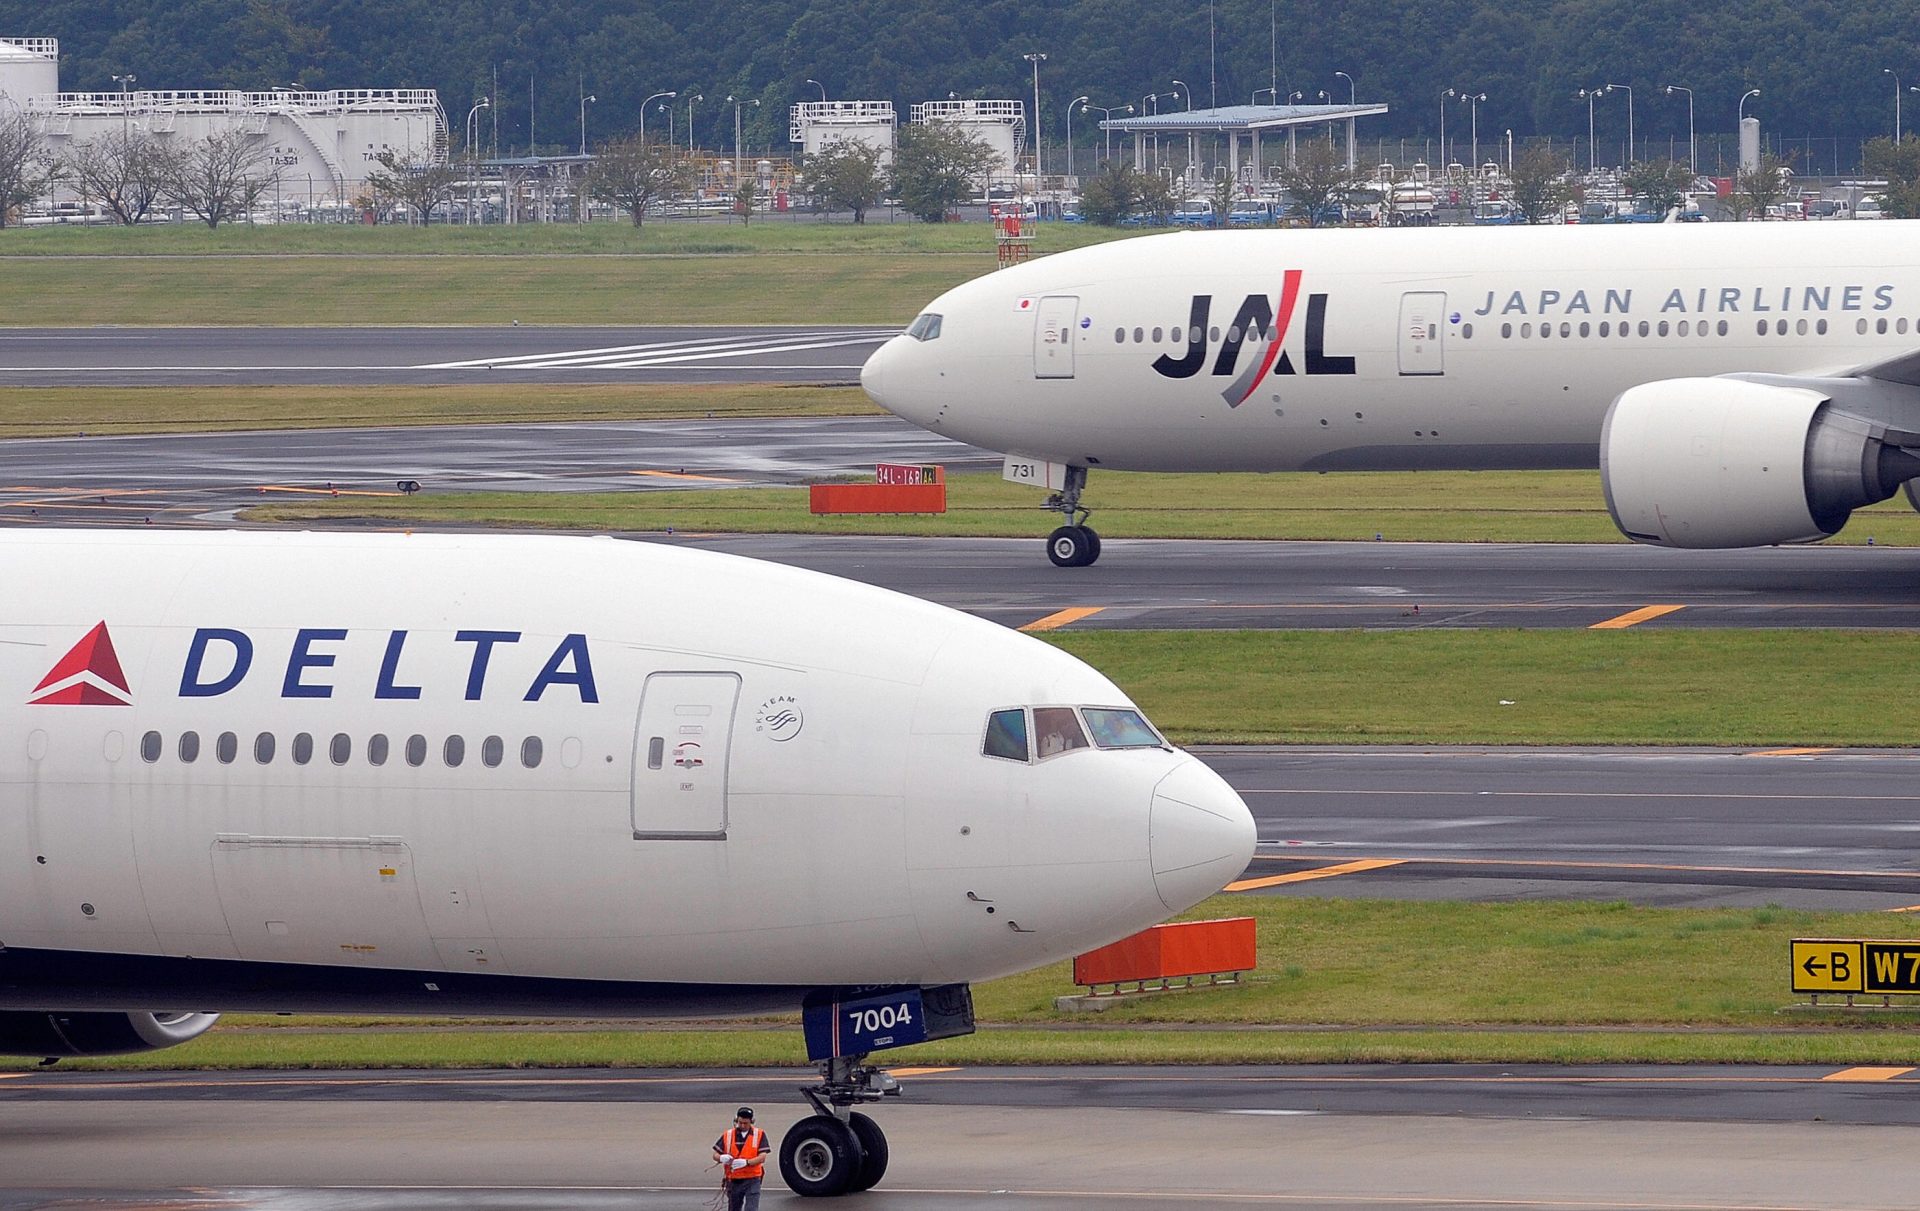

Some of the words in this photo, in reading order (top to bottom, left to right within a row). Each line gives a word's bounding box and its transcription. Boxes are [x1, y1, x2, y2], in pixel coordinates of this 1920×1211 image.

[269, 156, 298, 166] TA-321
[1474, 289, 1632, 316] JAPAN
[1659, 285, 1895, 313] AIRLINES
[1151, 269, 1356, 409] JAL
[1011, 464, 1035, 478] 731
[178, 628, 600, 704] DELTA
[755, 695, 796, 732] SKYTEAM
[1831, 952, 1850, 982] B
[1874, 952, 1920, 984] W7
[850, 1003, 912, 1034] 7004
